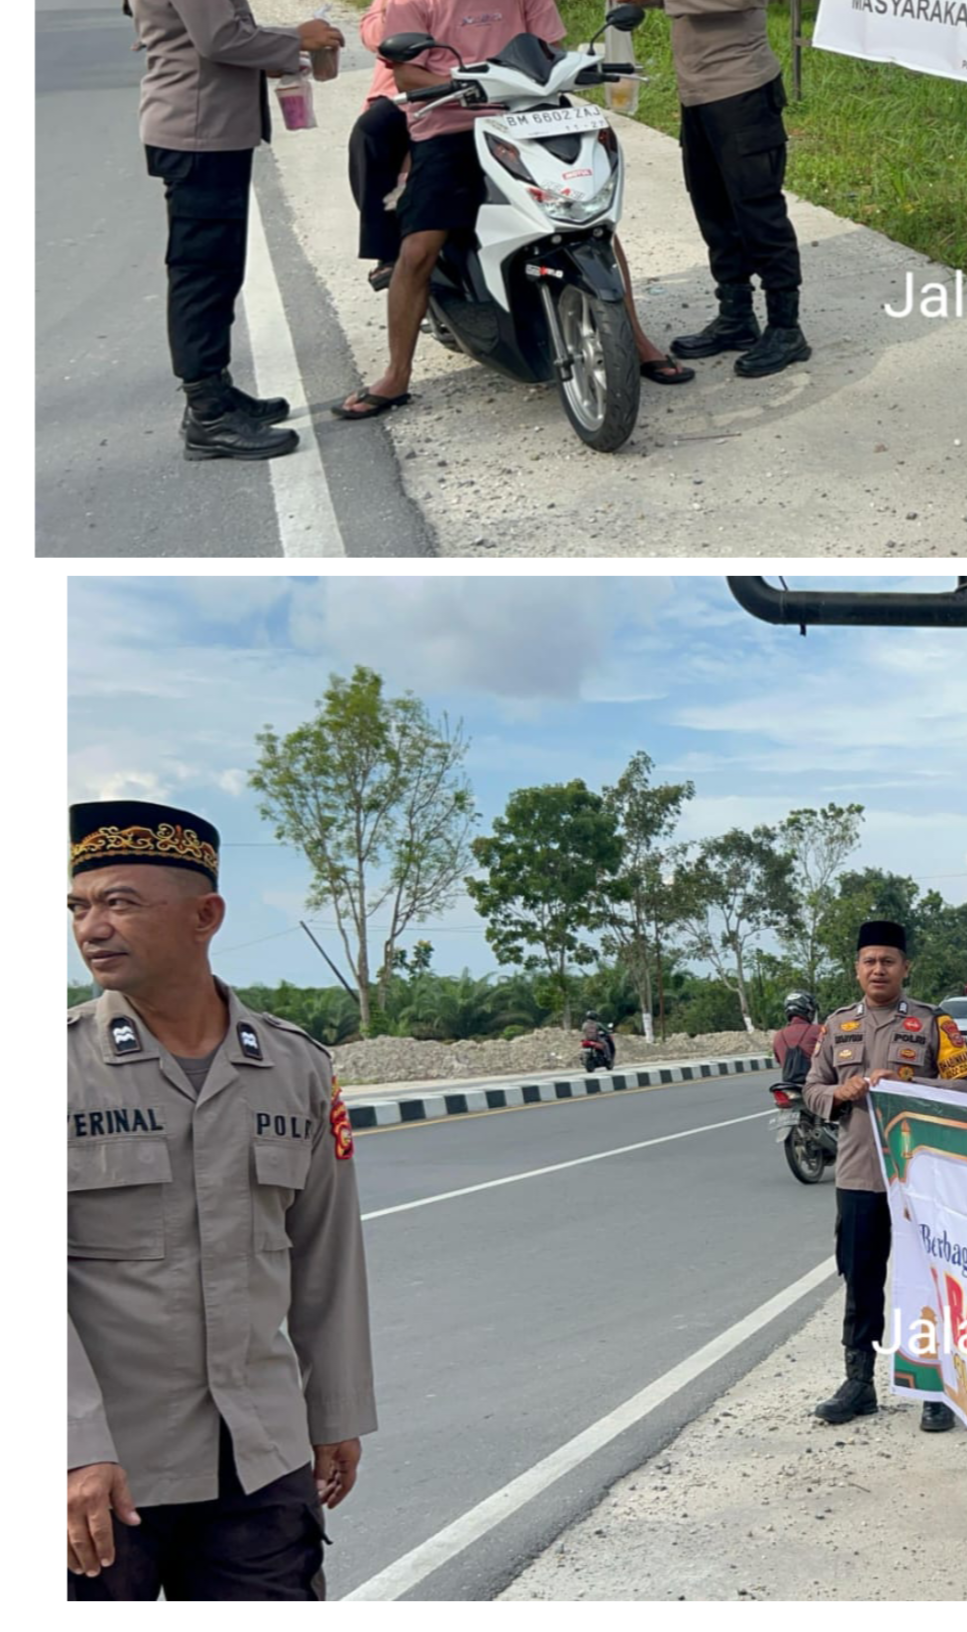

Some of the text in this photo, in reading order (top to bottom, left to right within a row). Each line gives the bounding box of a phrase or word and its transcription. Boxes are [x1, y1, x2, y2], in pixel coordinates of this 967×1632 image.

[506, 115, 529, 127] BM
[575, 107, 601, 120] ZAJ
[67, 1108, 164, 1138] ERINAL
